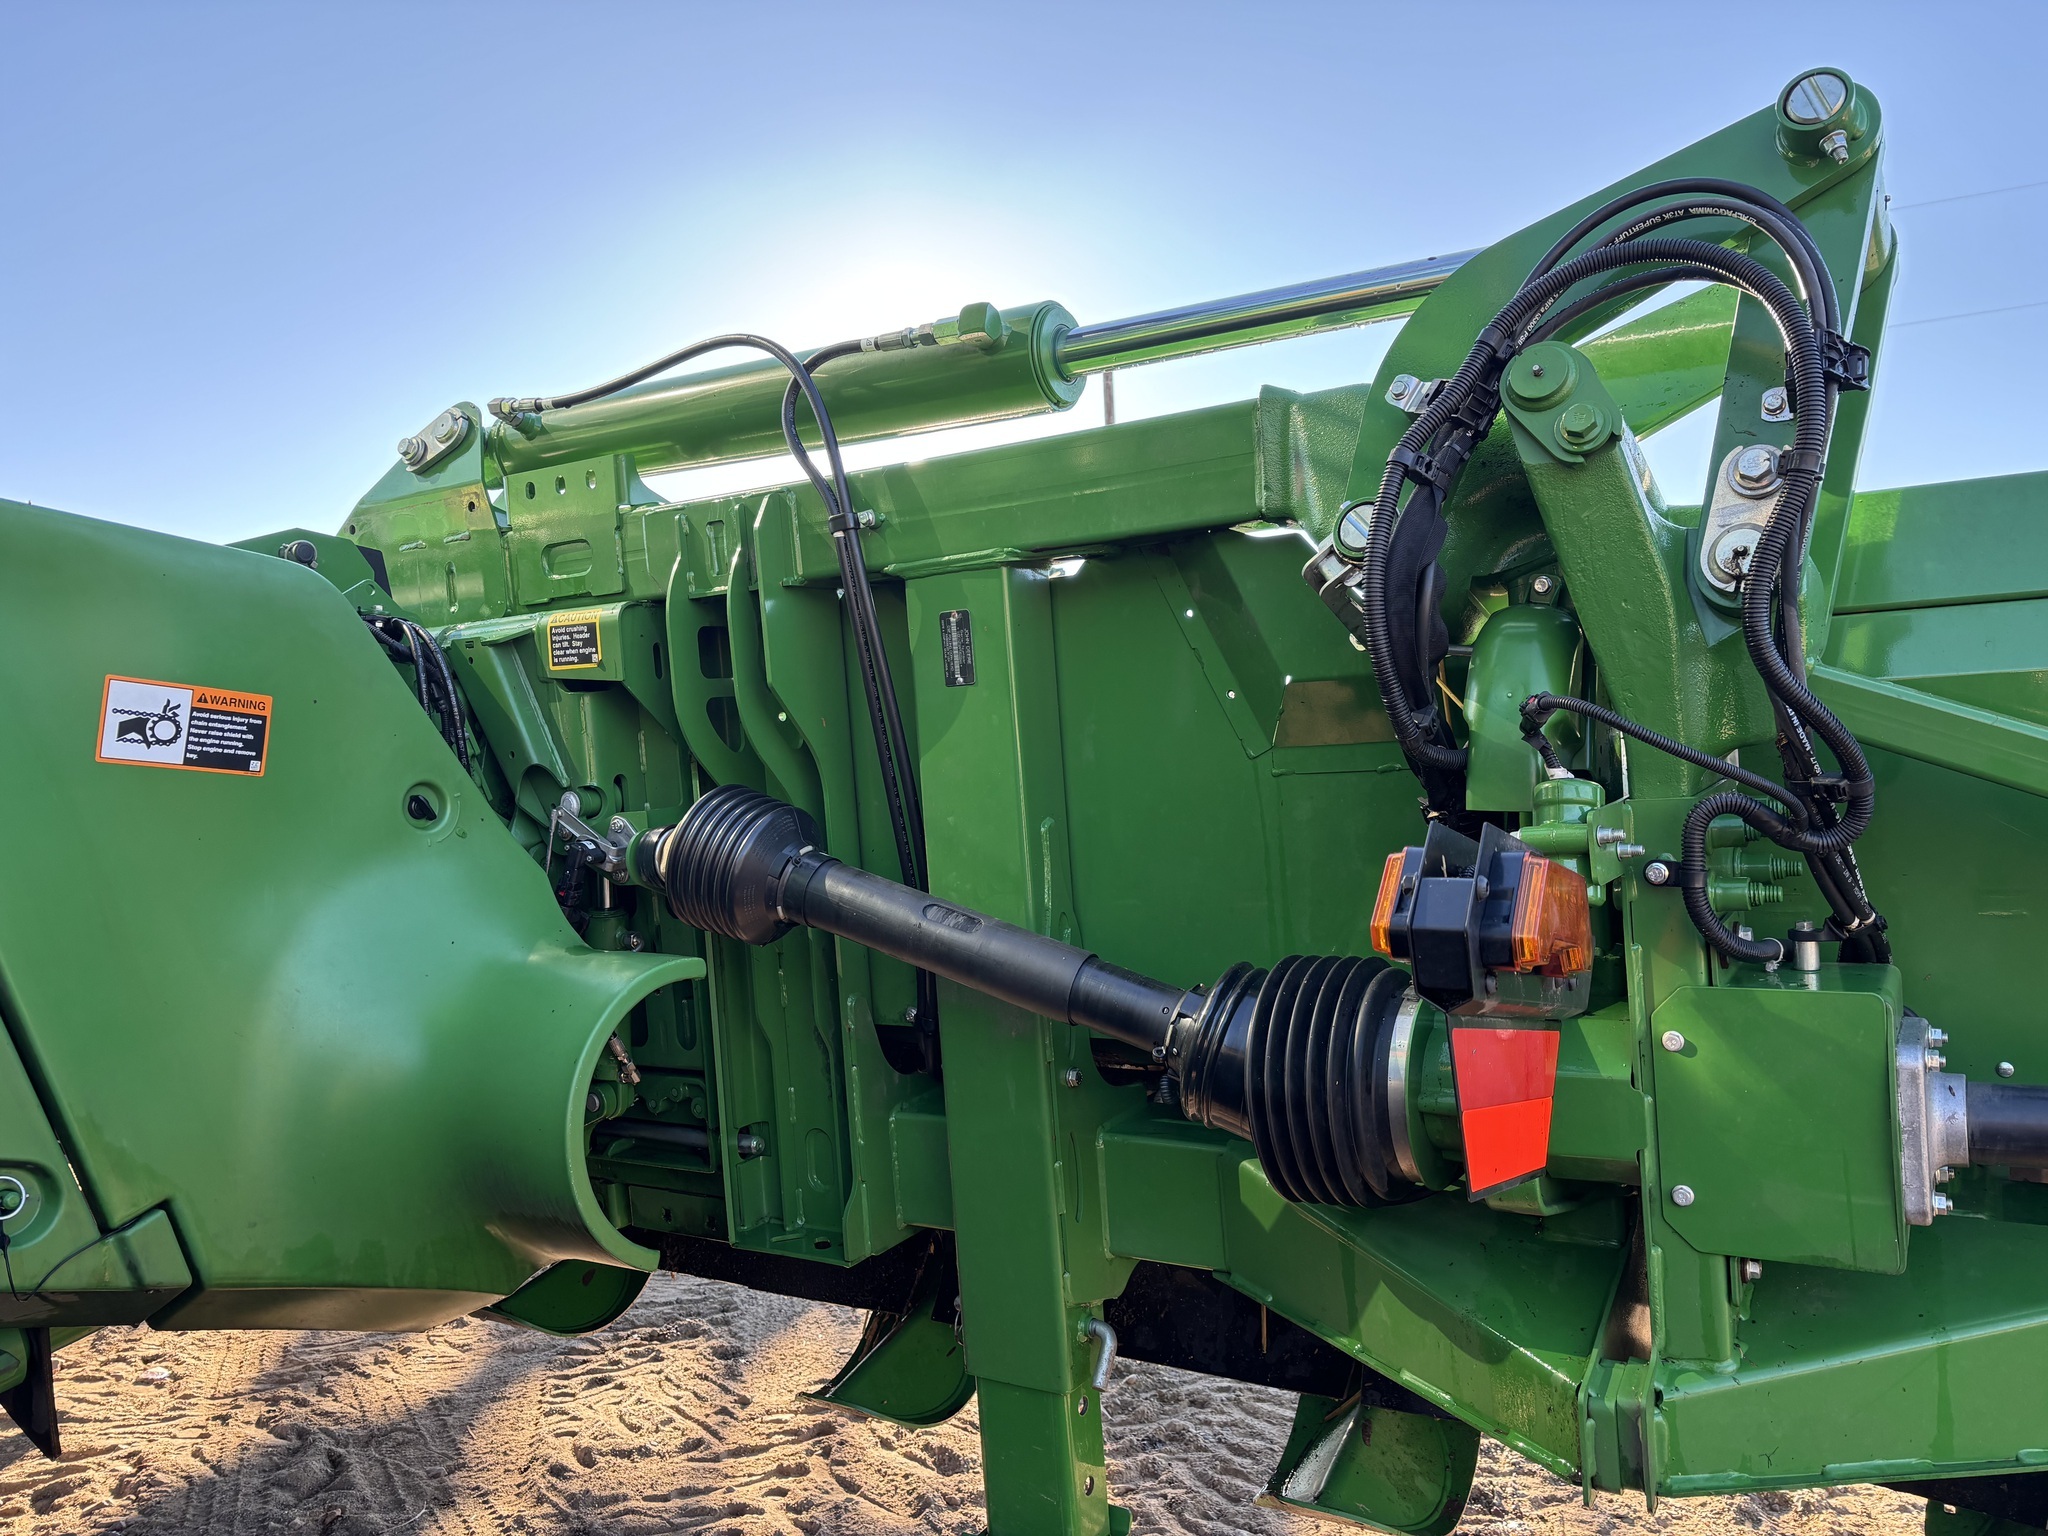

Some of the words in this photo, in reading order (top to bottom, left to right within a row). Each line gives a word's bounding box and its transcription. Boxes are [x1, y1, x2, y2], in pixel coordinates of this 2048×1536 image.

[1662, 208, 1684, 219] AT3K
[1613, 215, 1661, 245] SUPERTUFF
[559, 611, 599, 623] CAUTION
[210, 695, 265, 711] WARNING
[208, 722, 248, 731] entanglement.
[1792, 716, 1799, 726] IN
[1796, 726, 1811, 750] MADE
